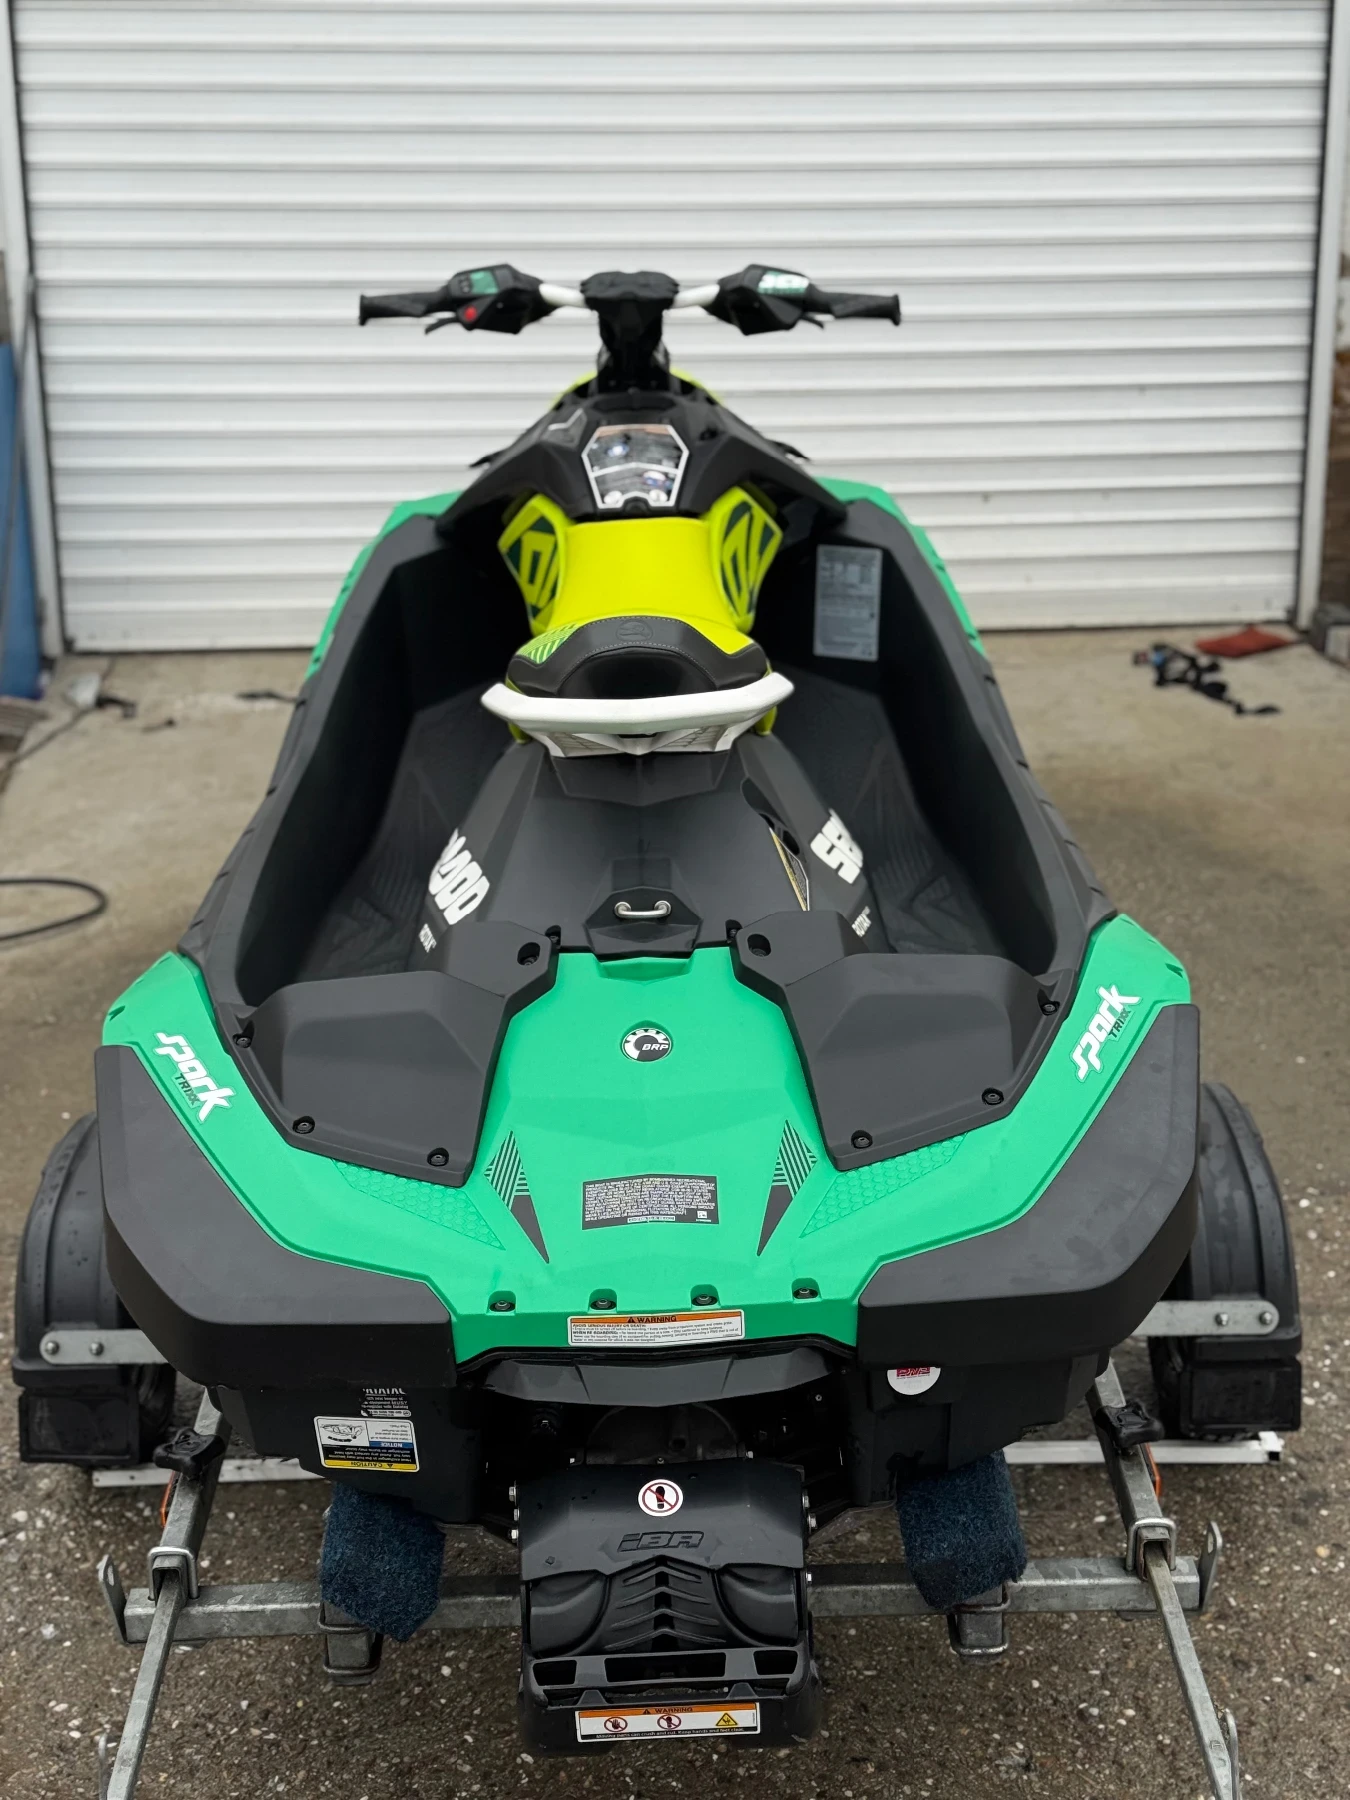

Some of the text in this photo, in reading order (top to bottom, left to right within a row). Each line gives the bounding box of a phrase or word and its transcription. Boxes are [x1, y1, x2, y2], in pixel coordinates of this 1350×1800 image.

[641, 1043, 669, 1051] BRP
[636, 1315, 678, 1324] WARNING
[654, 1706, 693, 1714] WARNING
